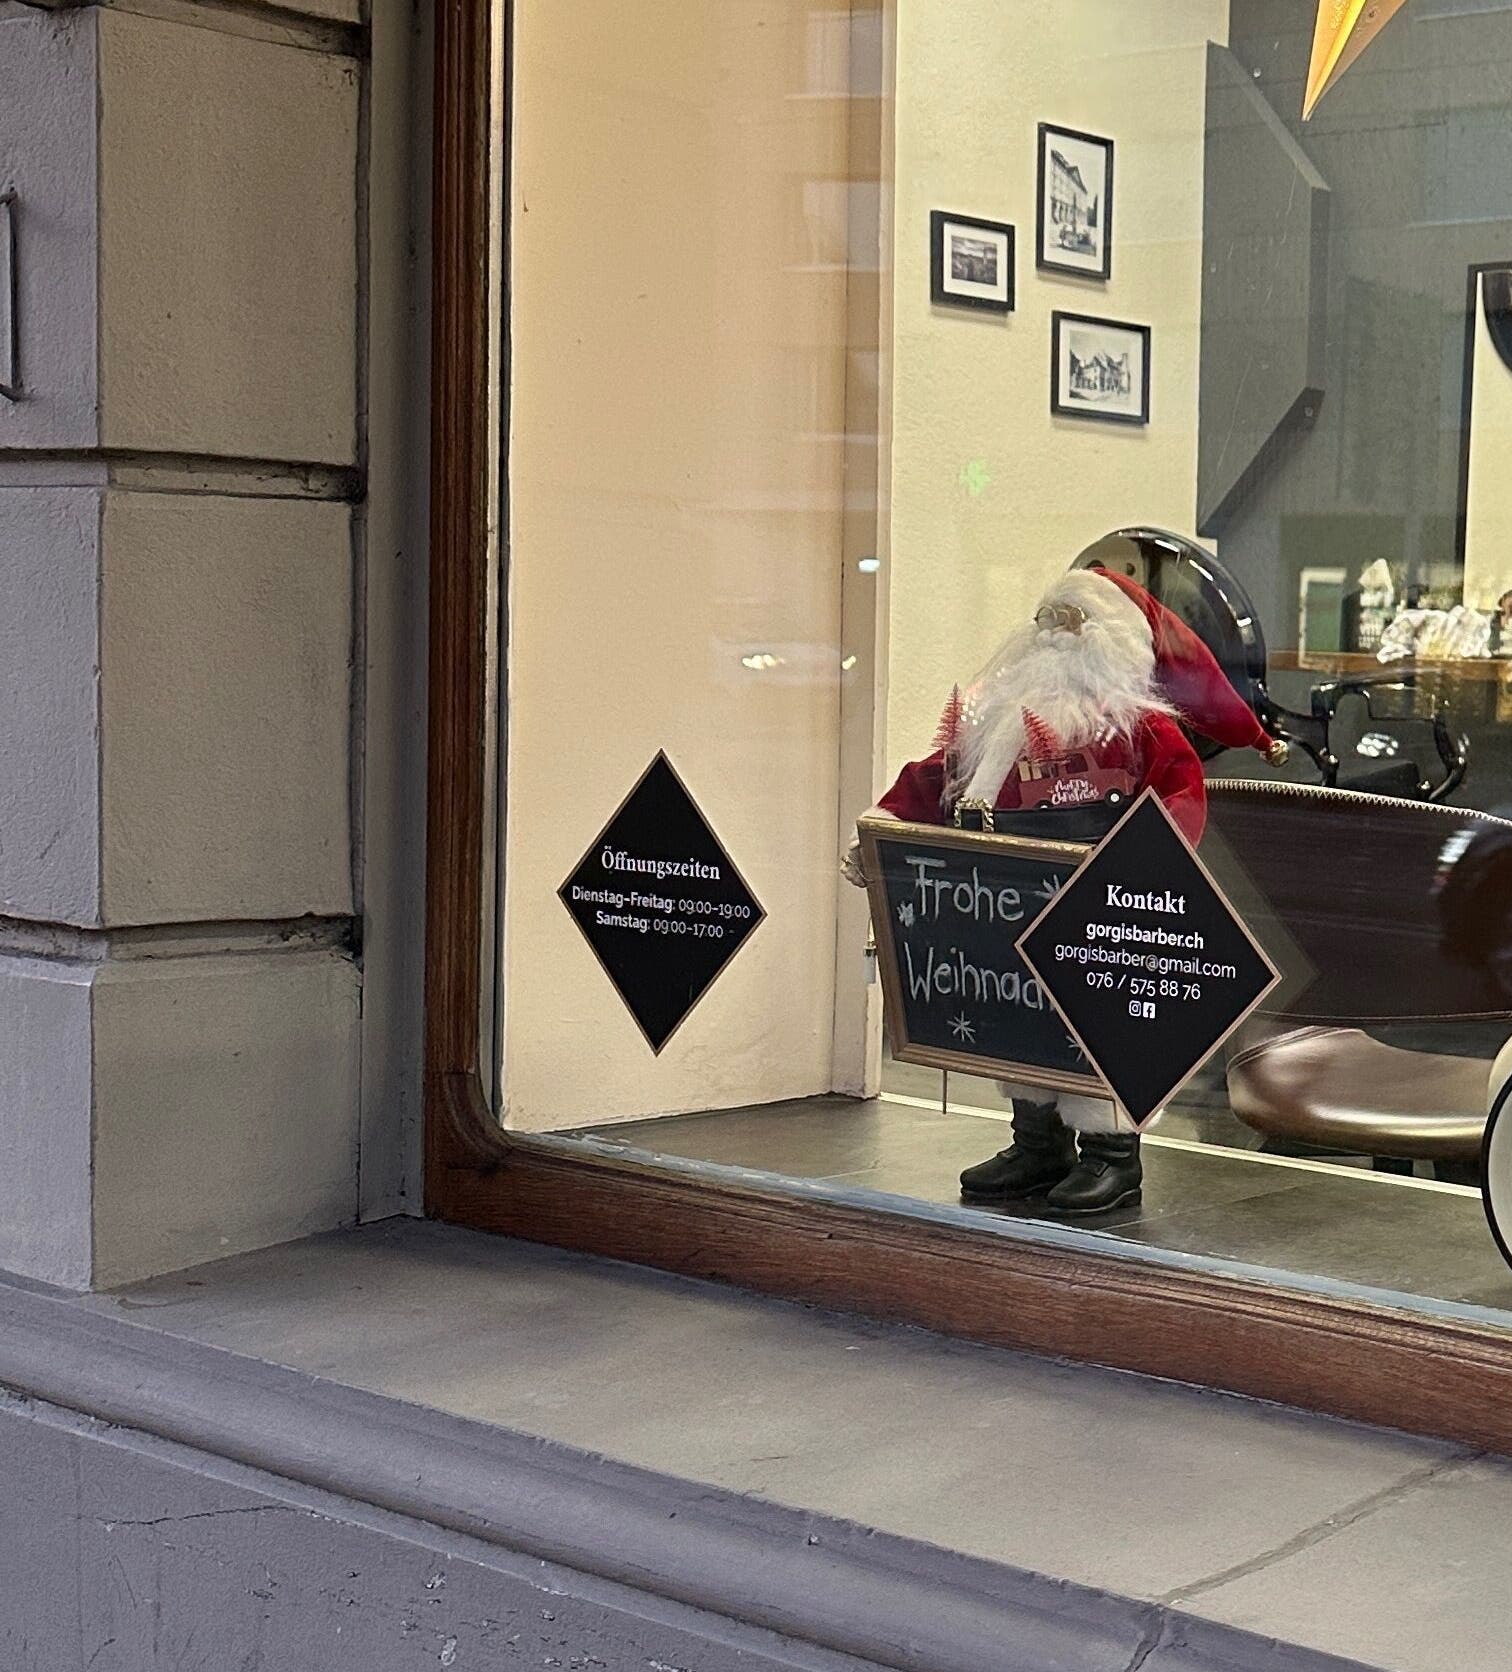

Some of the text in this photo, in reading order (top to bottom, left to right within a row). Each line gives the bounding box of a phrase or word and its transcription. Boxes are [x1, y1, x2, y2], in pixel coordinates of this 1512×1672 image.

[601, 845, 721, 880] Öffnungszeiten
[905, 856, 1025, 922] Frohe
[1106, 884, 1186, 914] Kontakt
[596, 910, 651, 933] Samstag:
[1086, 923, 1204, 950] gorgisbarber.ch
[1055, 944, 1236, 979] gorgisbarber@gmail.com
[1086, 972, 1201, 1000] 076 / 575 88 76
